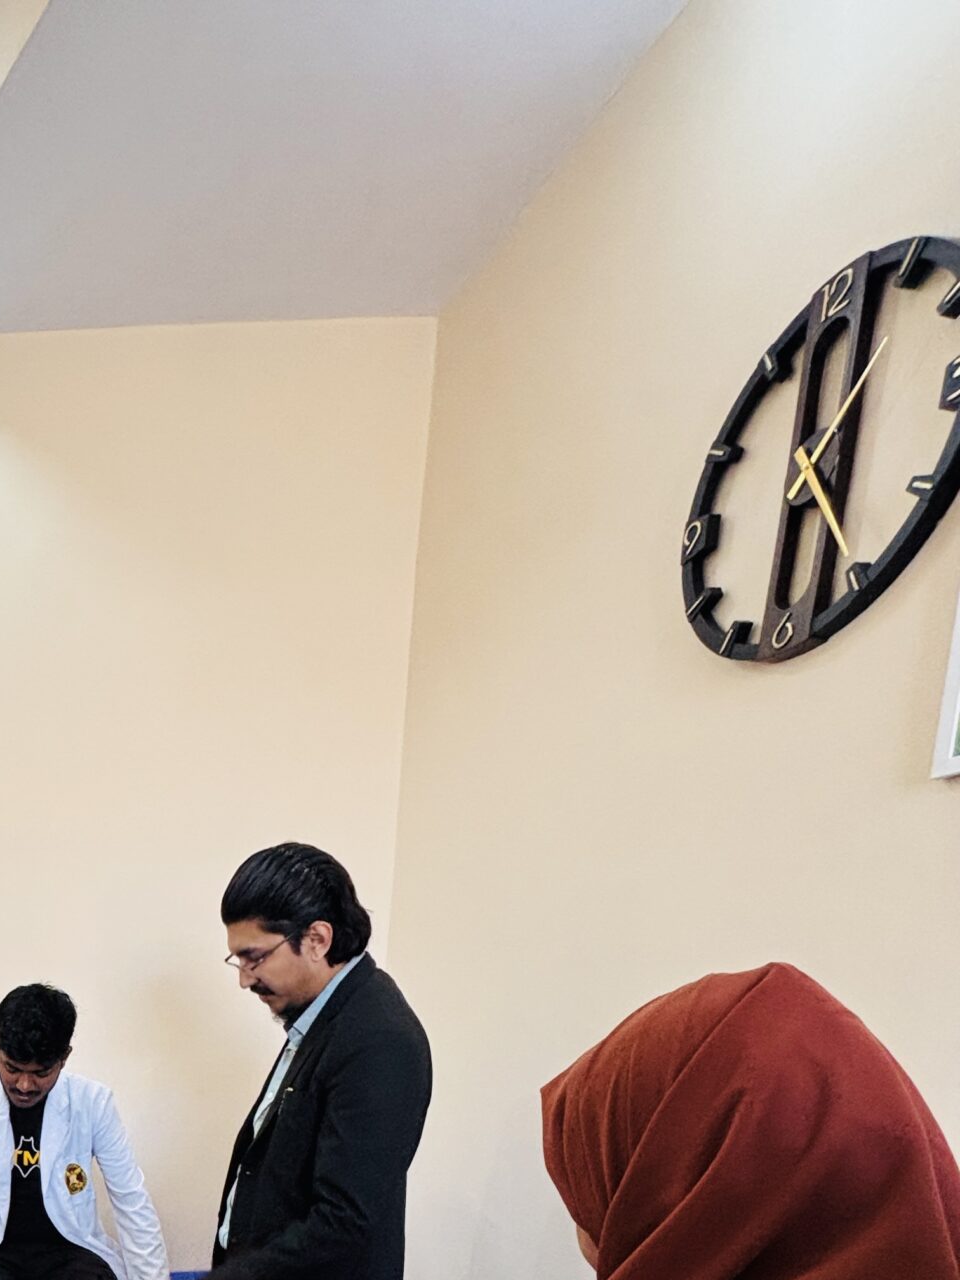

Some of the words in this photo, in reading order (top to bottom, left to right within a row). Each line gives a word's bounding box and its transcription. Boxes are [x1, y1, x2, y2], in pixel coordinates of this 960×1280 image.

[820, 268, 853, 322] 12
[684, 520, 702, 556] 9
[771, 611, 794, 649] 6
